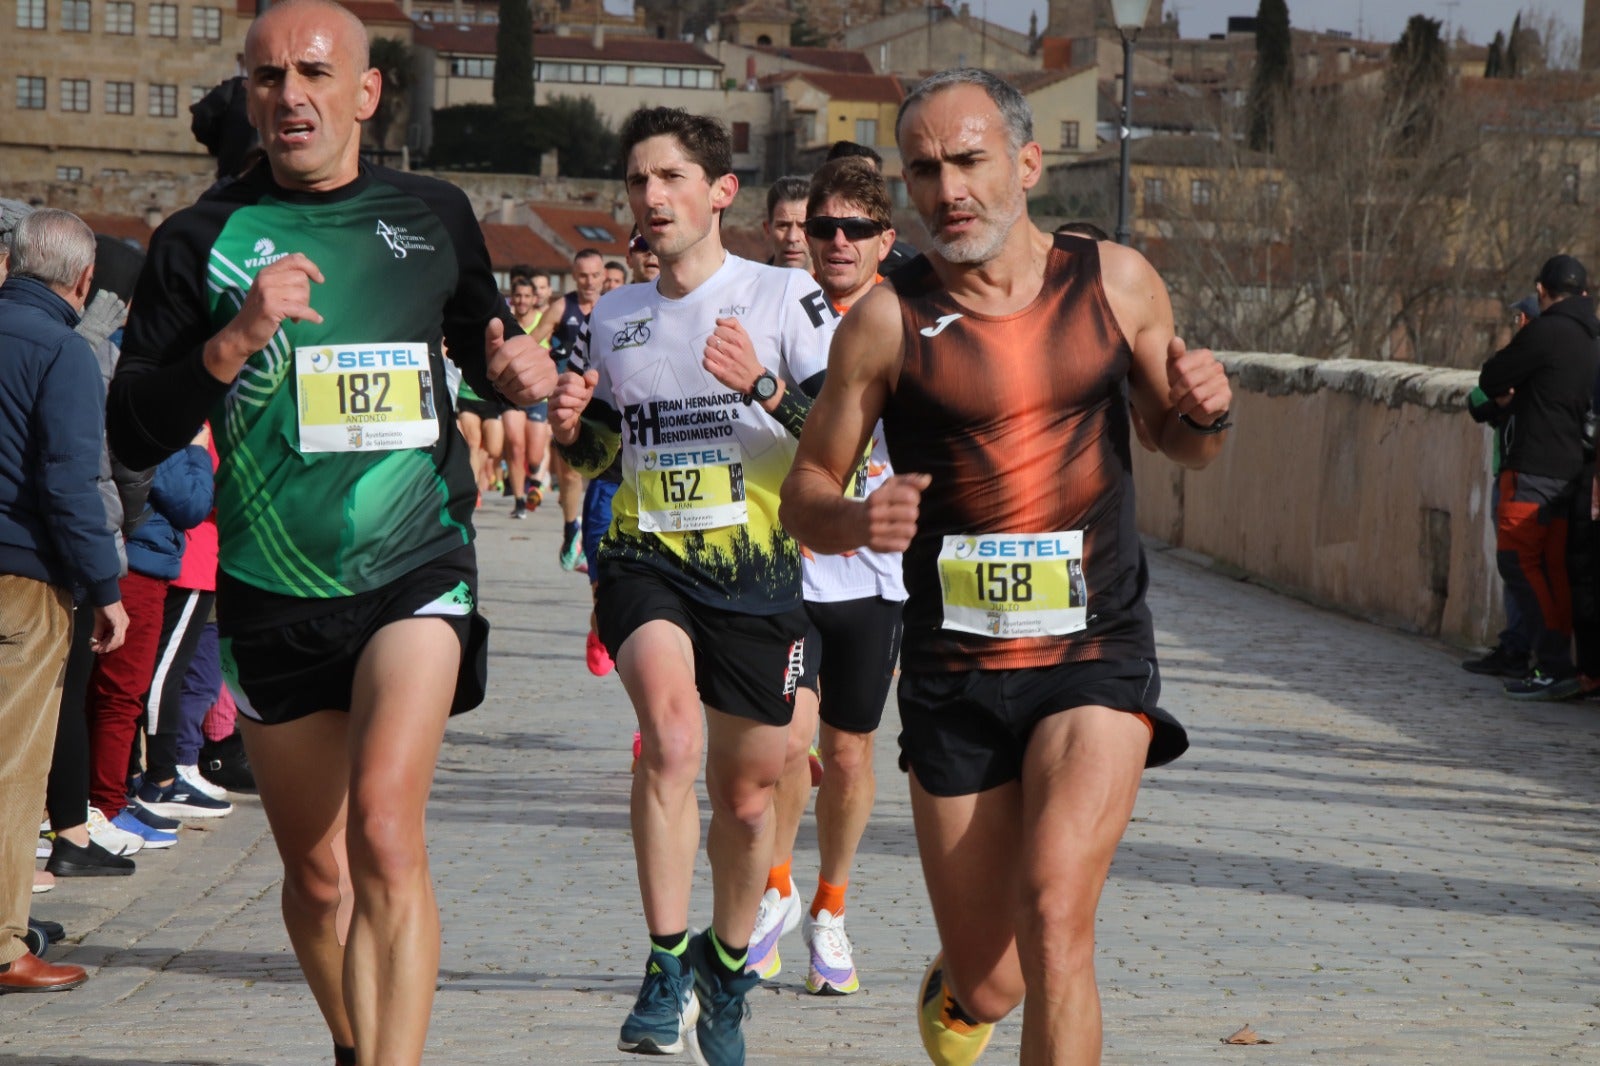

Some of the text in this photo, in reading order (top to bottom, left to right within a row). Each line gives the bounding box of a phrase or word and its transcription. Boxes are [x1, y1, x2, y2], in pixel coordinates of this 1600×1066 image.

[337, 349, 419, 368] SETEL
[336, 372, 393, 414] 182
[658, 392, 744, 413] FRAN HERNÁNDEZ
[346, 413, 387, 423] ANTONIO
[660, 408, 740, 428] BIOMECÁNICA &
[661, 425, 733, 444] RENDIMIENTO
[659, 449, 730, 467] SETEL
[660, 469, 704, 503] 152
[978, 539, 1070, 557] SETEL
[975, 562, 1032, 603] 158
[990, 603, 1020, 612] JULIO
